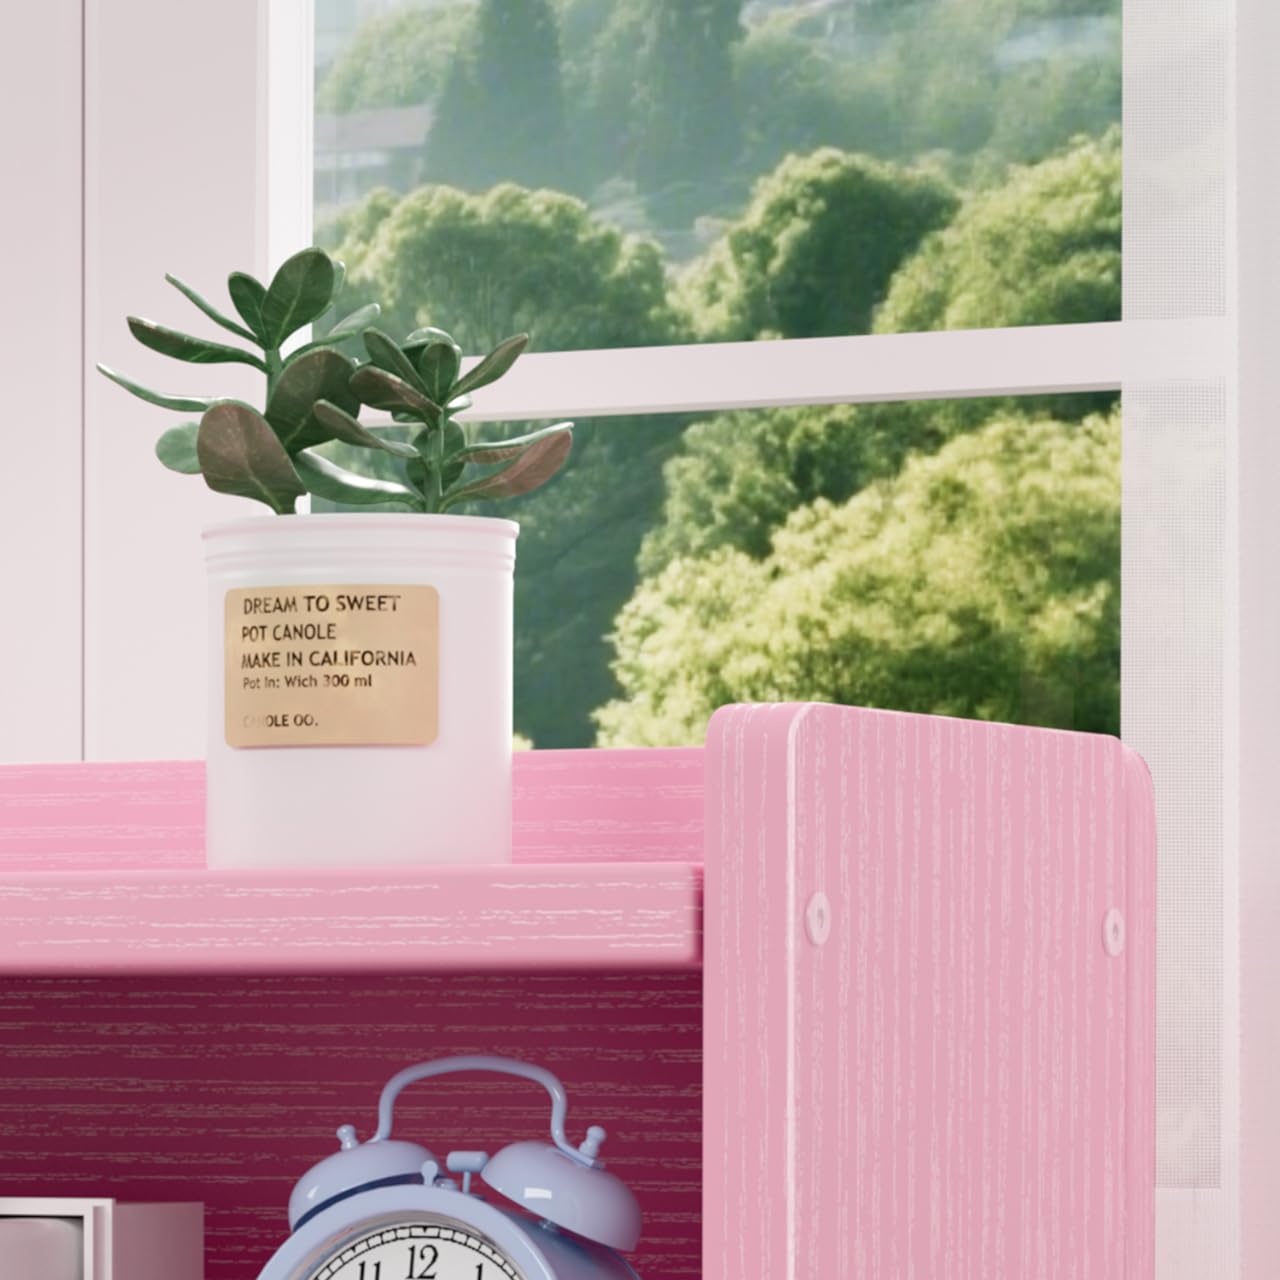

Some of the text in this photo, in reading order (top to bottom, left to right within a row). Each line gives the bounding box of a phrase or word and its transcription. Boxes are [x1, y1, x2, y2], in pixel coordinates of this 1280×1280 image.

[243, 594, 401, 615] DREAM TO SWEET
[242, 624, 268, 642] POT
[241, 650, 417, 669] MAKE IN CALIFORNIA
[242, 677, 261, 689] Pot
[322, 674, 350, 687] 300
[353, 673, 373, 687] ml
[405, 1244, 439, 1280] 12
